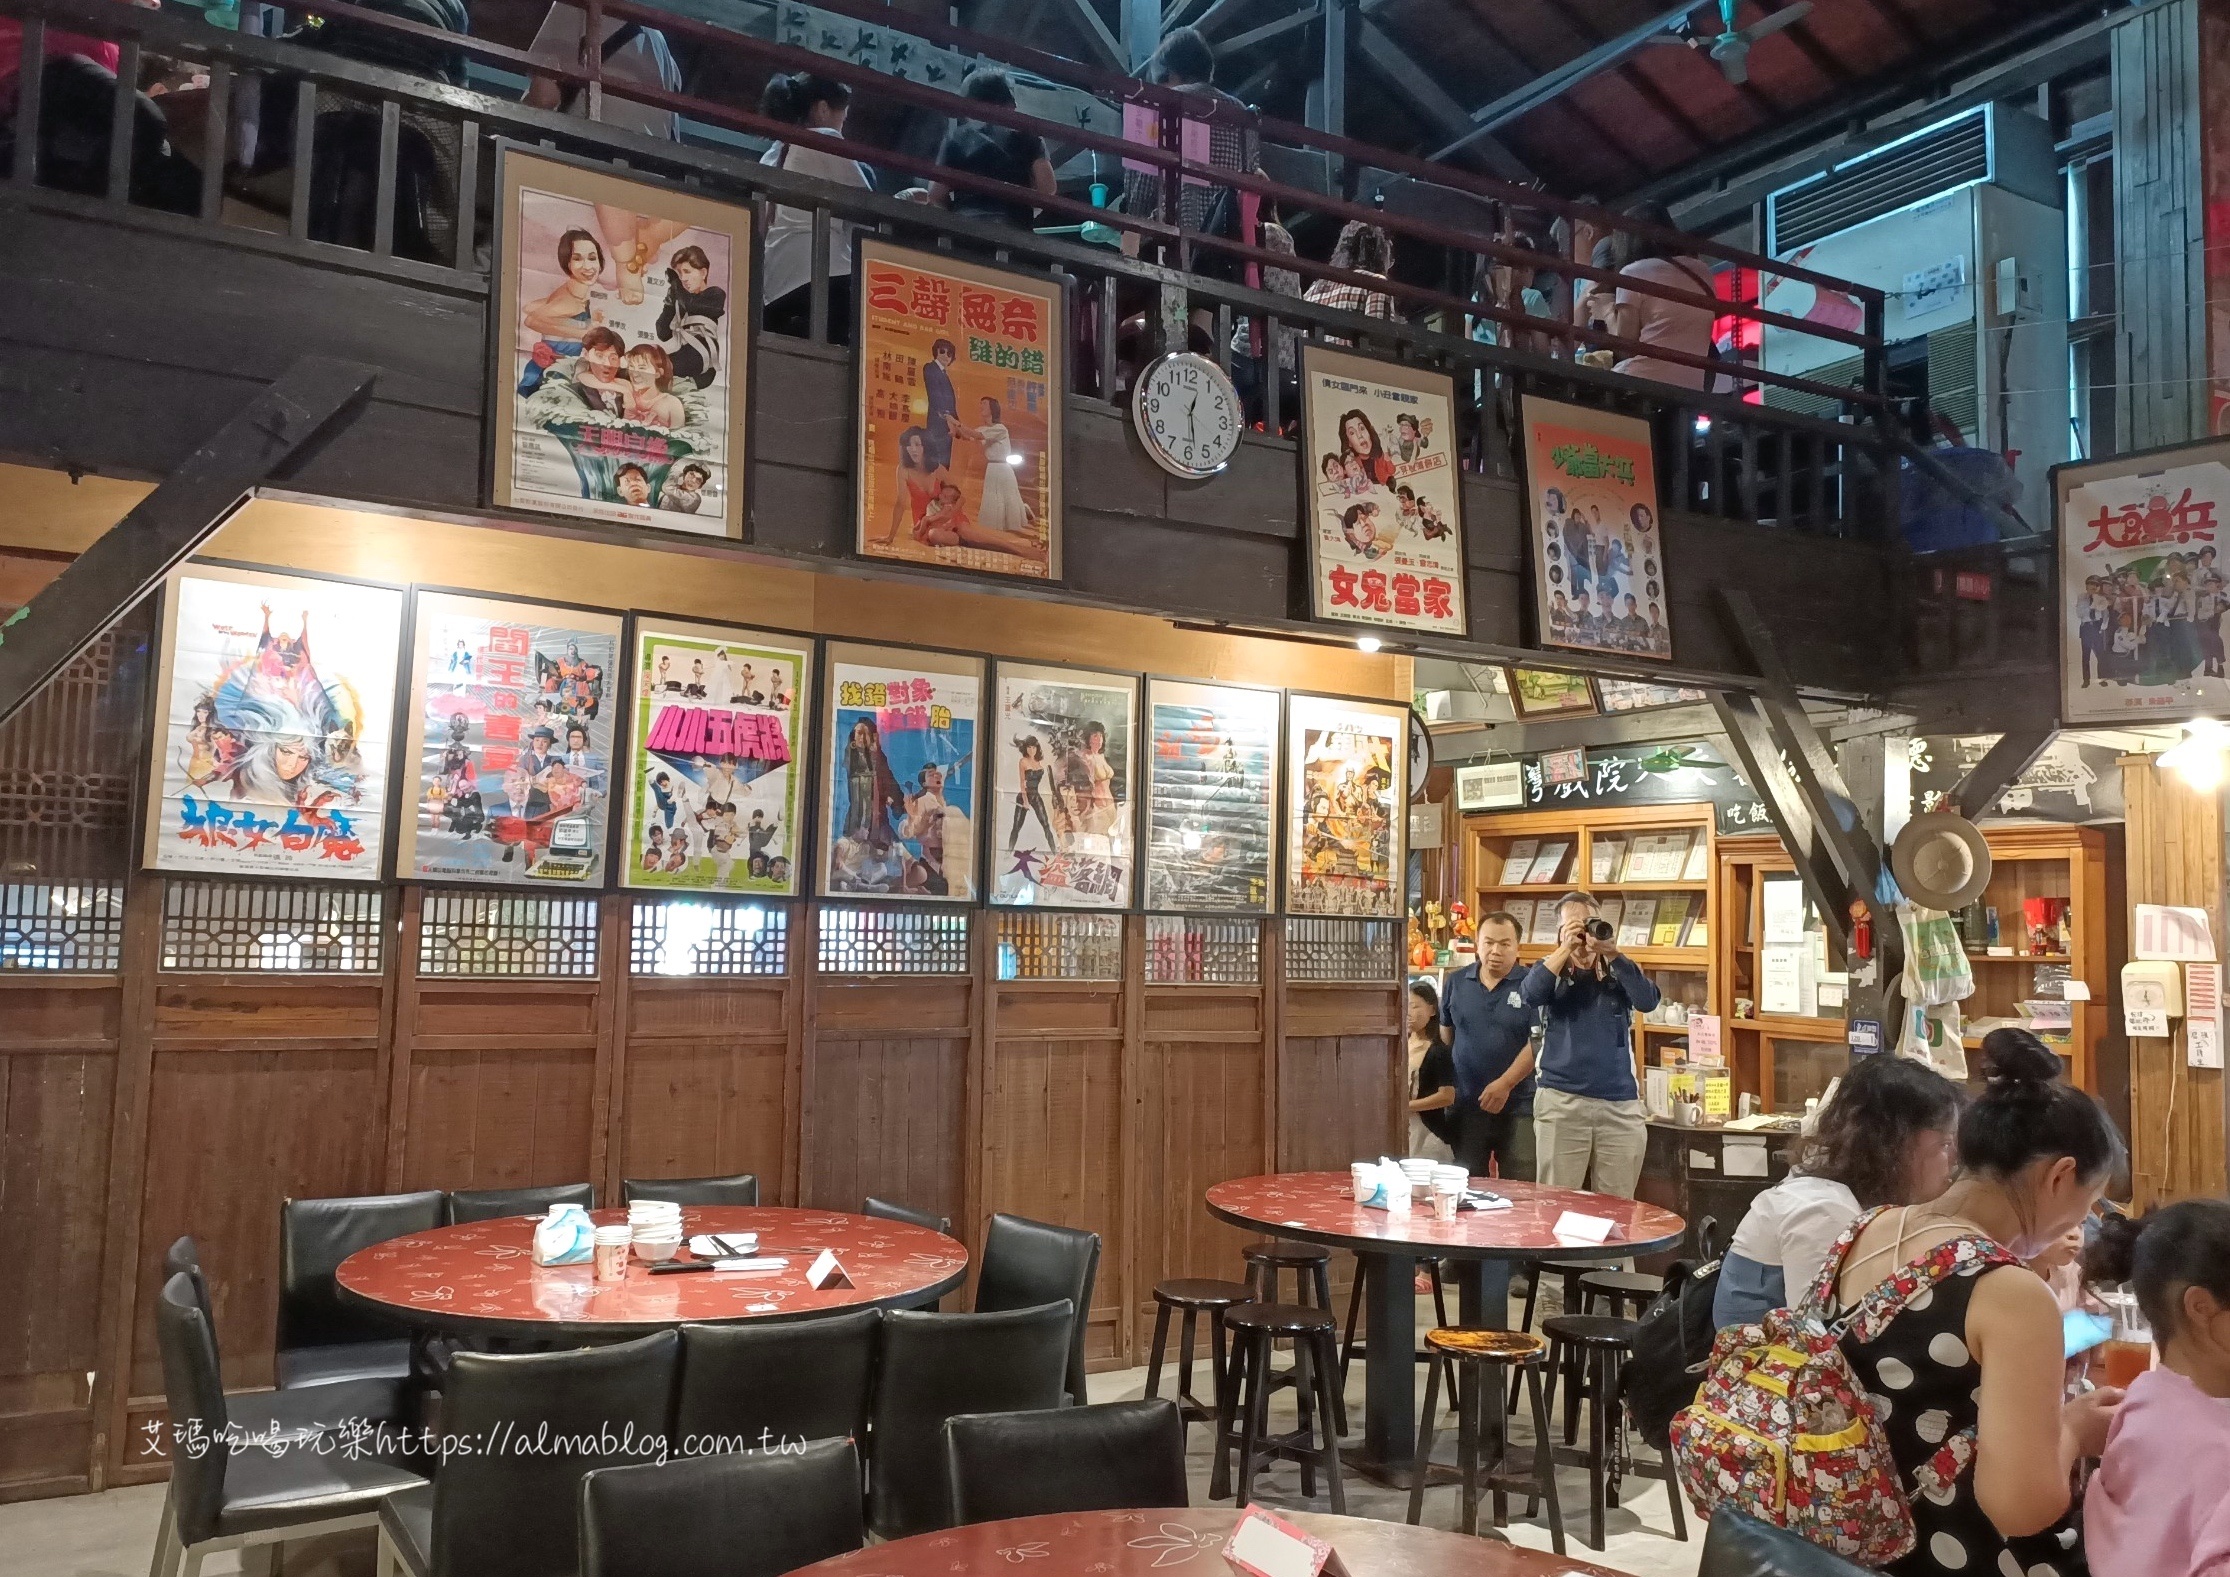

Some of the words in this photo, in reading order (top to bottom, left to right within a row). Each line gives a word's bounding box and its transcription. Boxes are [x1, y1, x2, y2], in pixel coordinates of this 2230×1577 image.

[869, 273, 1038, 343] 三聲無奈
[969, 336, 1044, 376] 誰的錯
[1169, 370, 1181, 385] 11
[1184, 368, 1198, 384] 12
[1157, 381, 1171, 397] 10
[1206, 380, 1211, 394] 1
[1150, 398, 1160, 413] 9
[1214, 396, 1224, 410] 2
[1155, 419, 1165, 434] 8
[1218, 415, 1228, 430] 3
[1168, 435, 1177, 449] 7
[1213, 434, 1222, 448] 4
[1183, 445, 1193, 460] 6
[1201, 444, 1210, 459] 5
[1328, 564, 1454, 619] 女鬼當家
[840, 678, 934, 707] 找錯對象
[176, 793, 366, 862] 狼女白魔
